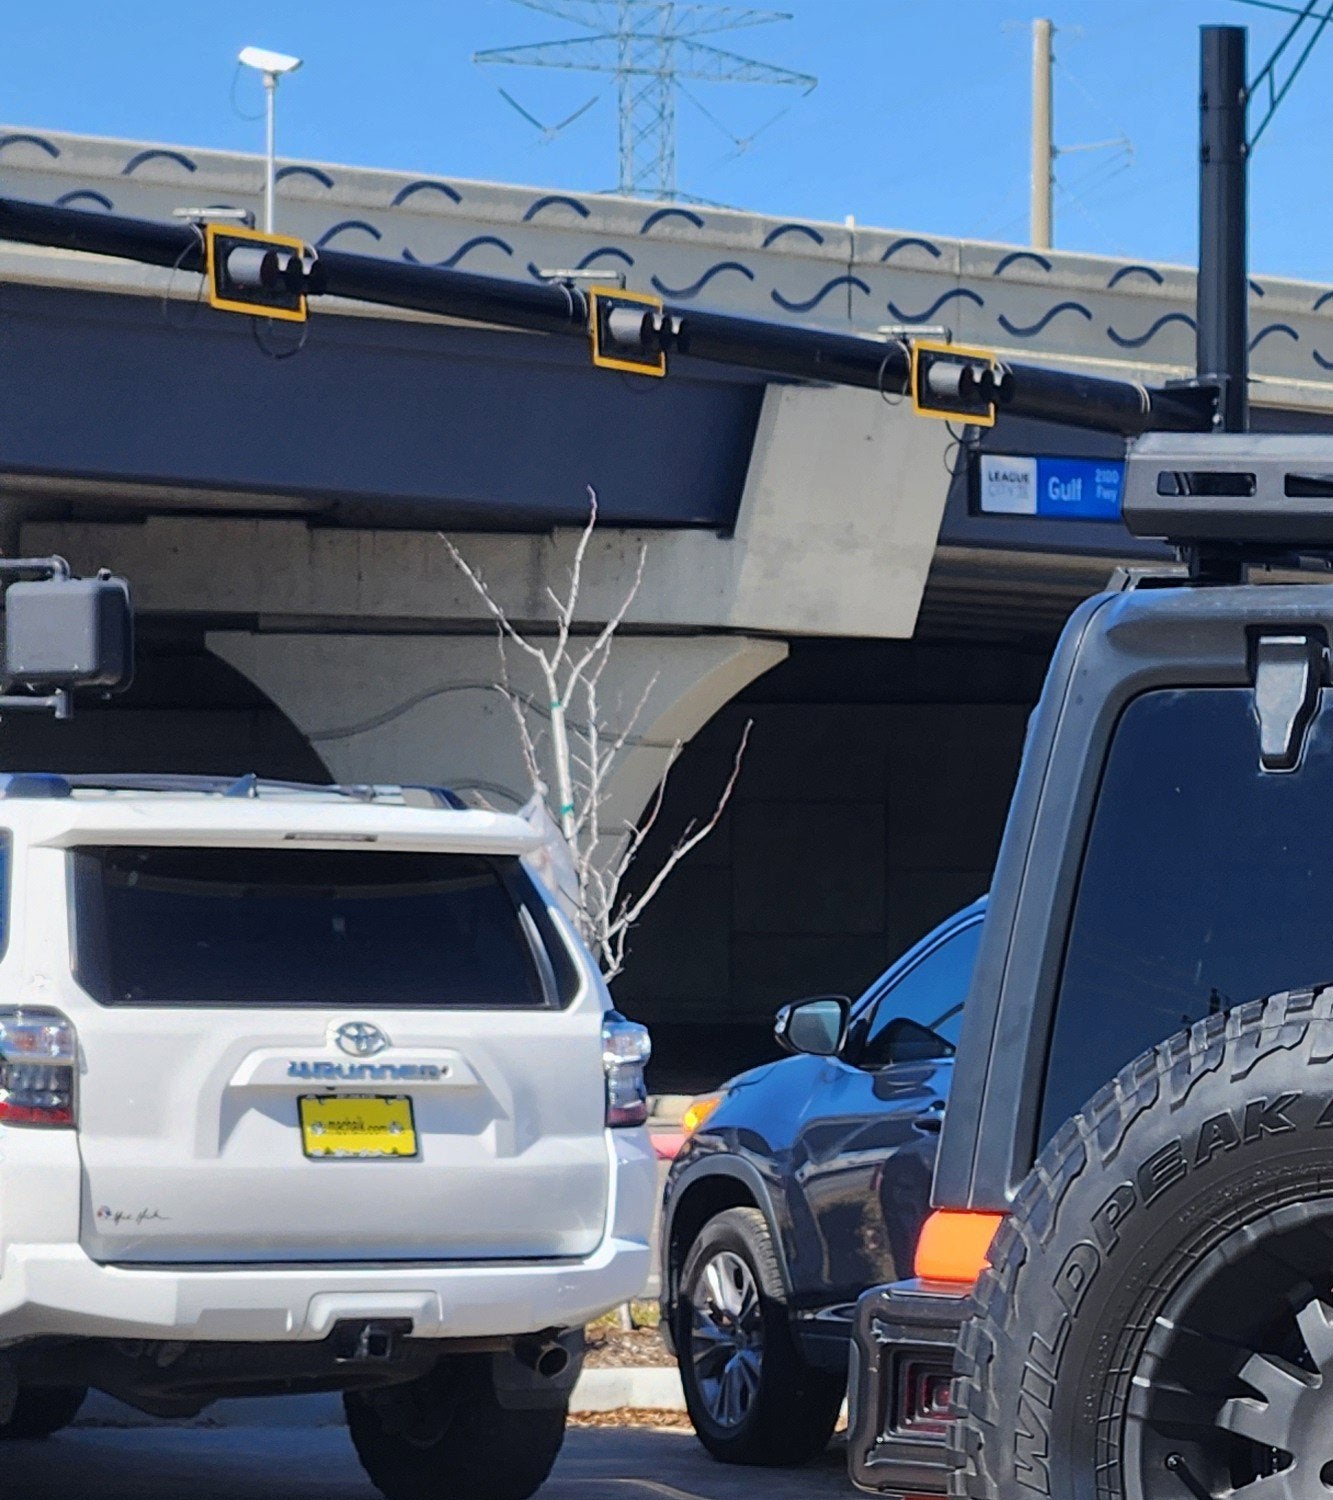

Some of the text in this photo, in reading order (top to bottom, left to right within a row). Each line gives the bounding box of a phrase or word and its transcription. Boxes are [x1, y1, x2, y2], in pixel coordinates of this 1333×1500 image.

[988, 471, 1030, 484] LEAGUE
[1048, 476, 1083, 502] Gulf
[1012, 1090, 1301, 1497] WILDPEAK
